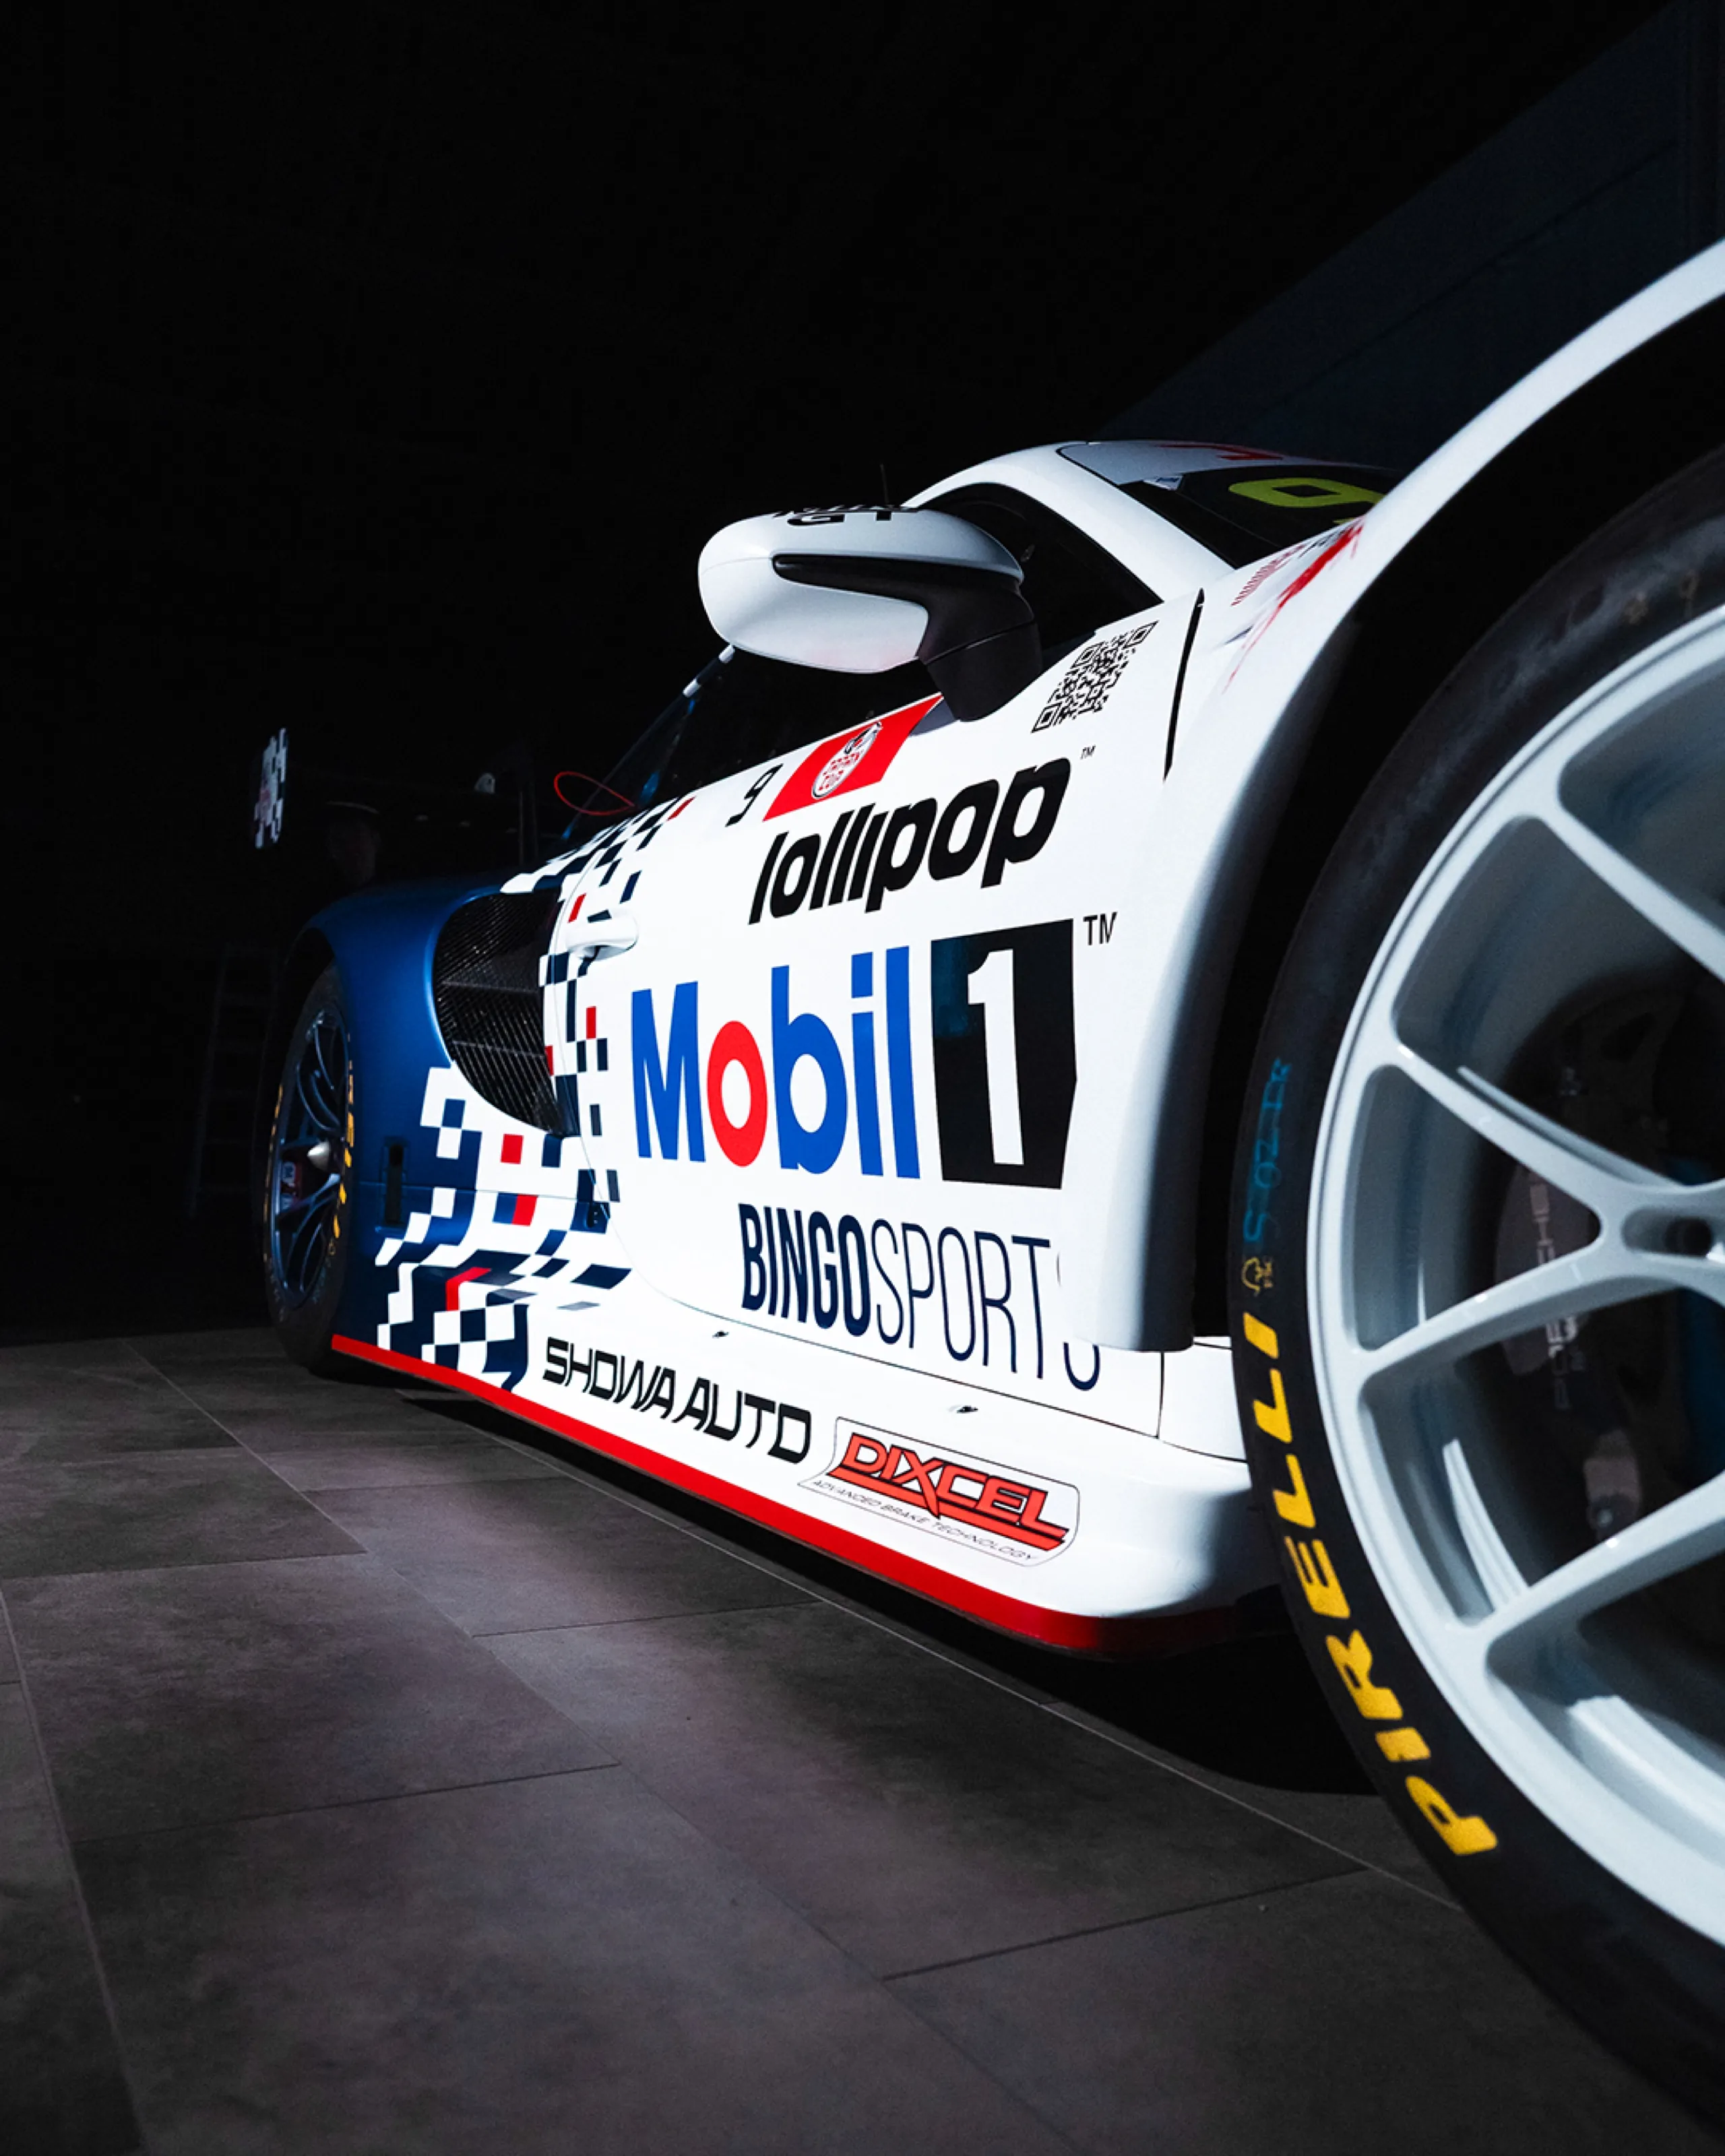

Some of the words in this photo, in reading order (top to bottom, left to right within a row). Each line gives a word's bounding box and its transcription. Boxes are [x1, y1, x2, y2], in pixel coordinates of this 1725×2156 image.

[725, 763, 784, 827] 9
[748, 757, 1071, 925] lollipop
[631, 945, 920, 1180] Mobil
[968, 948, 1025, 1166] 1
[1083, 912, 1118, 945] TM
[542, 1336, 677, 1420] SHOWA
[671, 1376, 812, 1465] AUTO
[840, 1432, 1071, 1542] DIXCEL
[1243, 1311, 1498, 1856] PIRELLI
